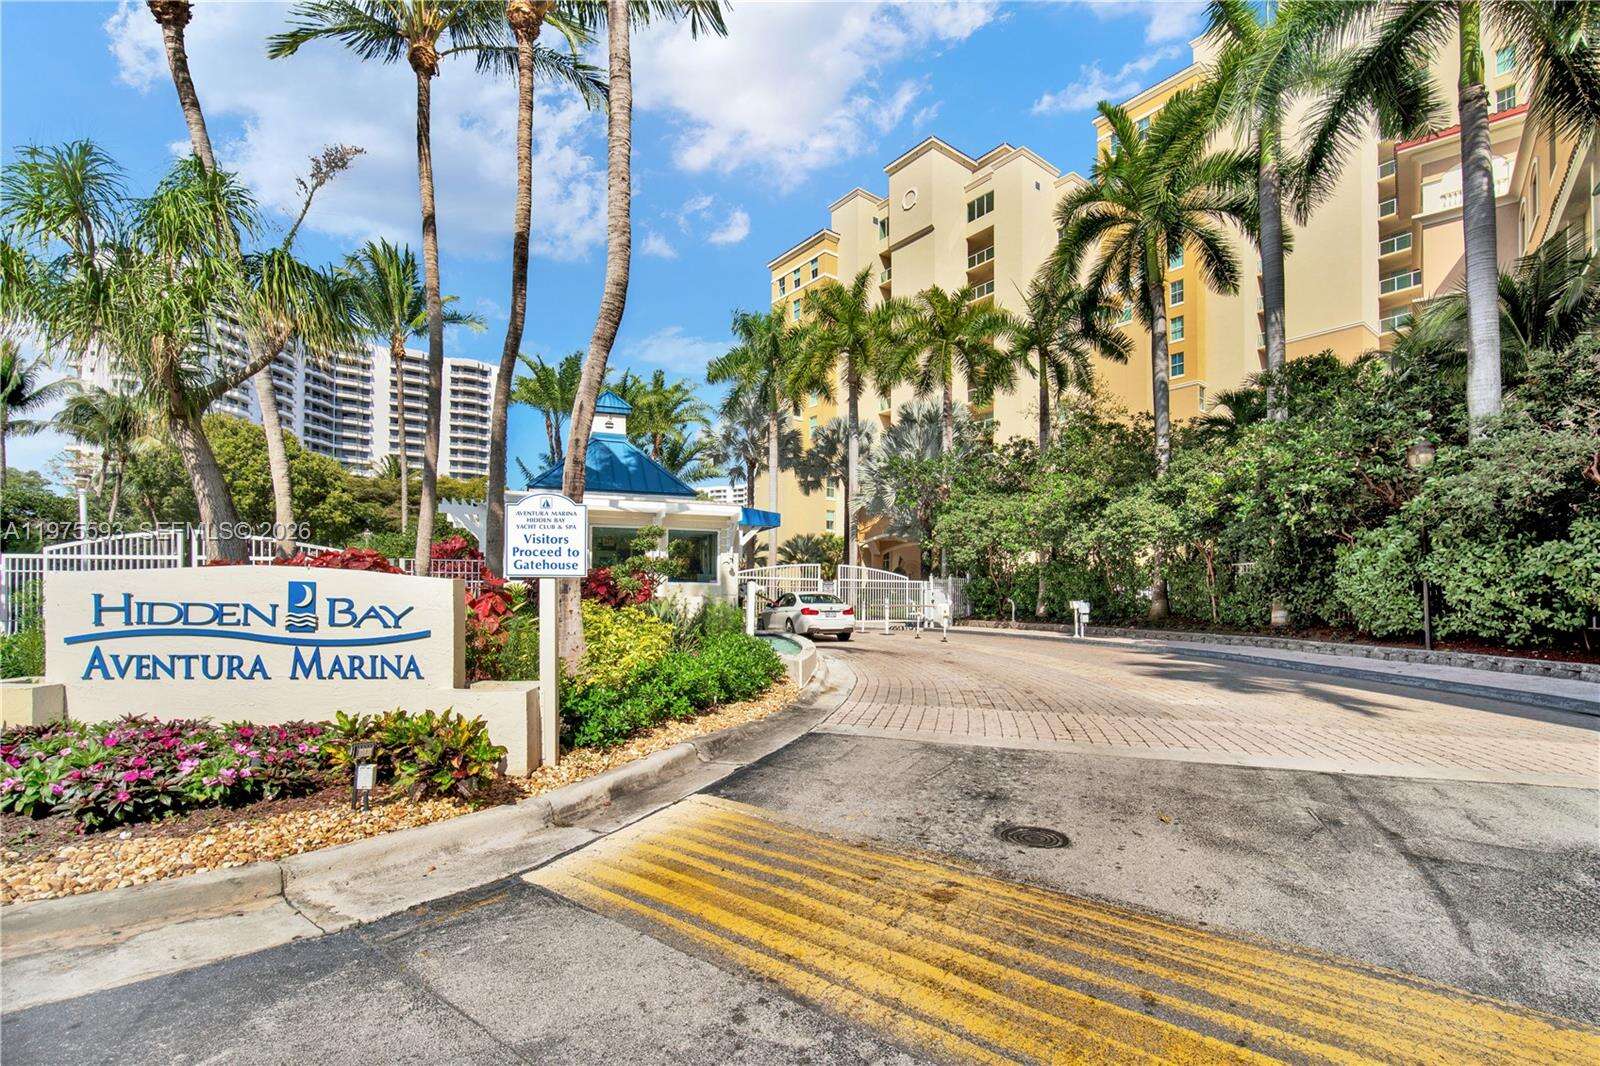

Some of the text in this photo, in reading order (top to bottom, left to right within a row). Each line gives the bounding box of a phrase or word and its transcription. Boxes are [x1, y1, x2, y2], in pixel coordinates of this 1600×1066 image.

[523, 533, 569, 544] Visitors
[512, 546, 580, 557] Proceed to
[513, 559, 579, 570] Gatehouse
[92, 592, 414, 628] HIDDEN BAY
[81, 645, 425, 680] AVENTURA MARINA
